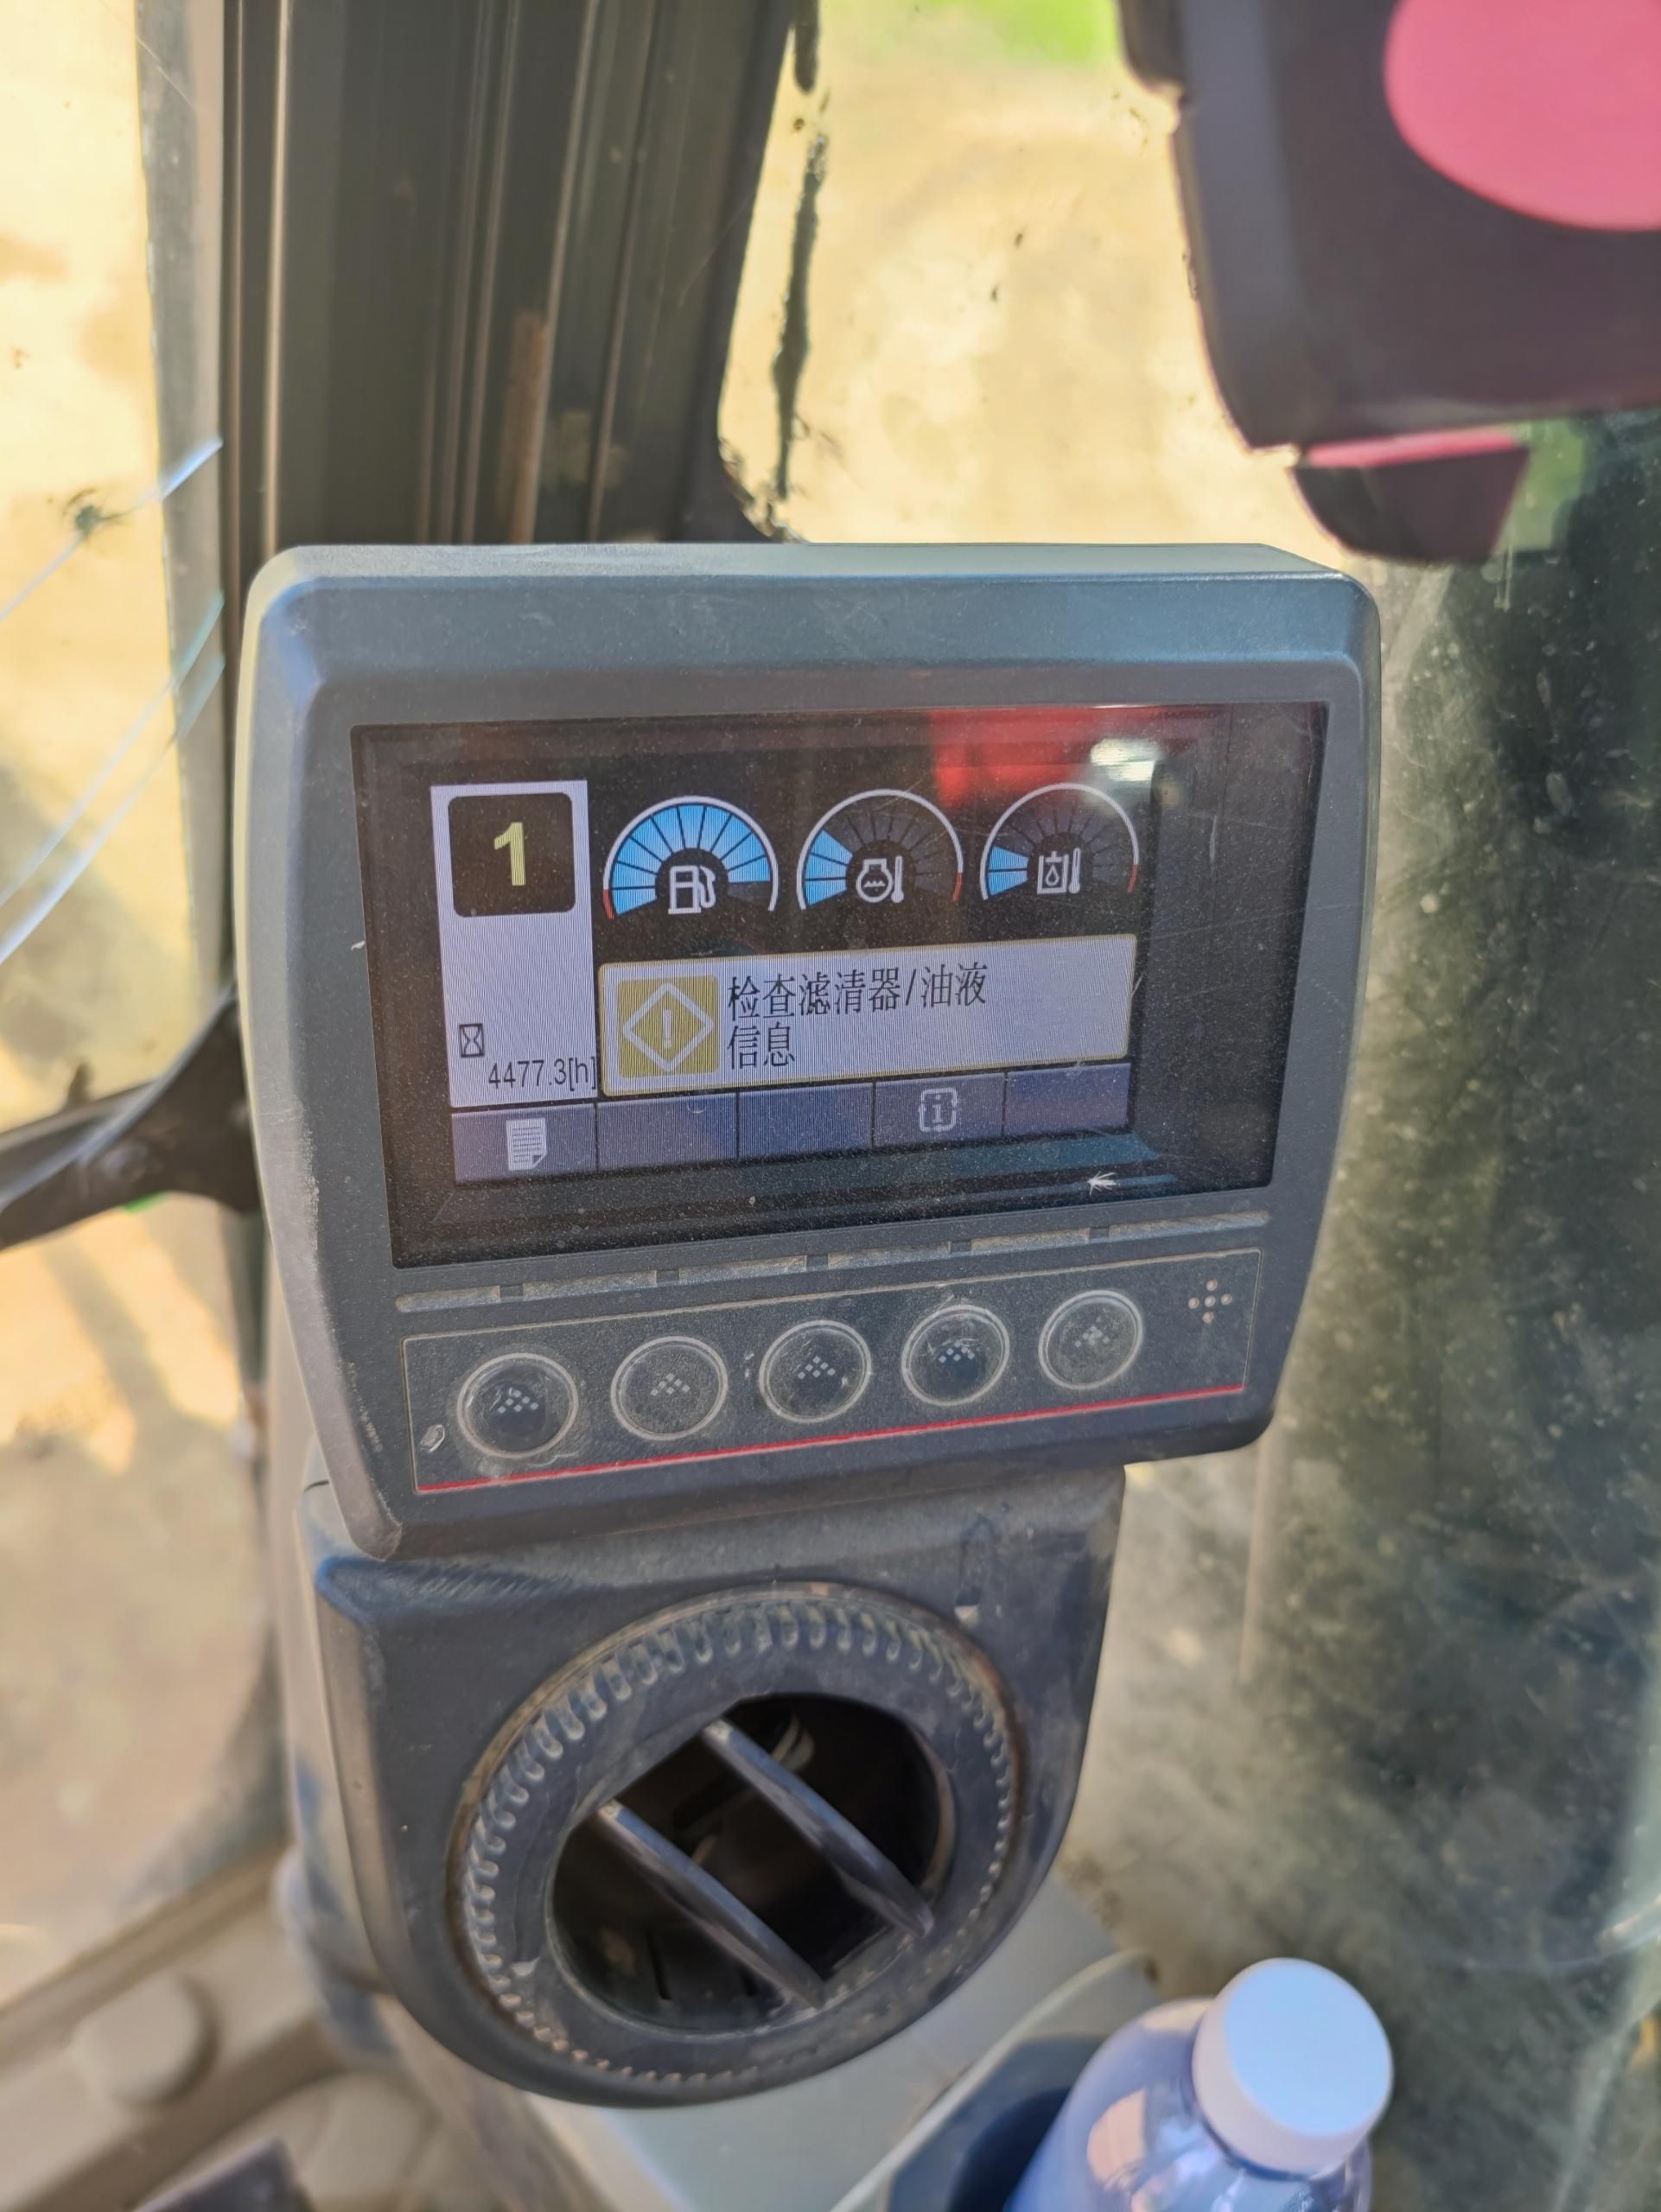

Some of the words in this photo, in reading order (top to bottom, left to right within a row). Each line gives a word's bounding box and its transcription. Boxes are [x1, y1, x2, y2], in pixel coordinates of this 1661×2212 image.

[493, 822, 525, 887] 1
[727, 961, 988, 1021] 检查滤清器/油液
[727, 1021, 796, 1070] 信息
[488, 1056, 597, 1091] 4477.3[h]
